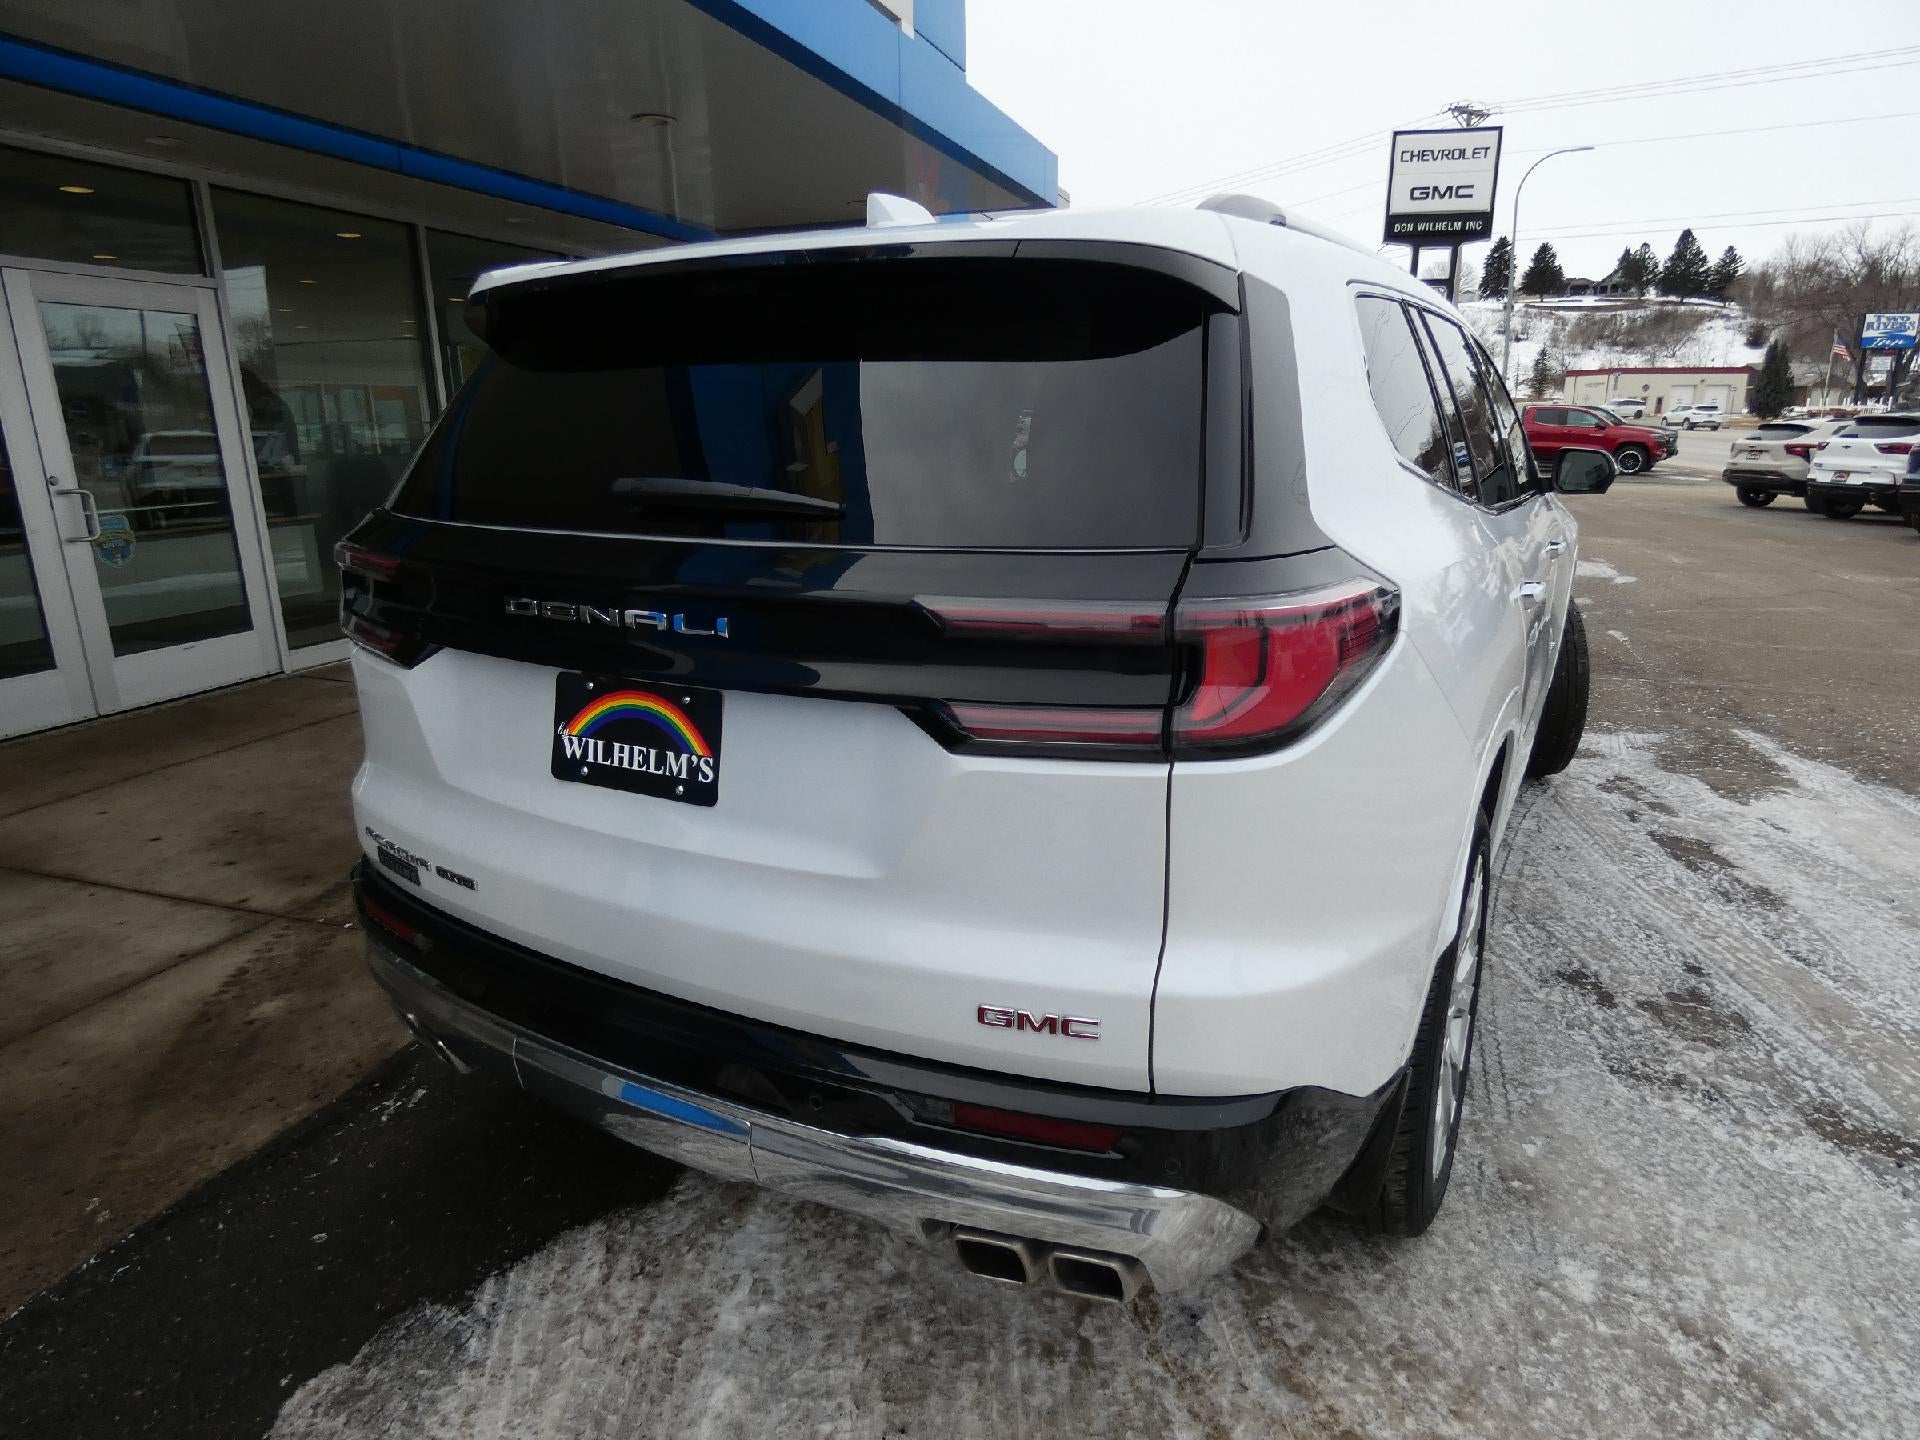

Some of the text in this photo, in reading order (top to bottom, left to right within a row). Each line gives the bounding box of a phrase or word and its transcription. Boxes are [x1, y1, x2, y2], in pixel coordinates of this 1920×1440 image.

[1400, 146, 1491, 163] CHEVROLET
[1409, 184, 1475, 201] GMC
[1393, 220, 1483, 233] DON WILHELM INC
[504, 596, 729, 639] DENALI
[562, 734, 715, 784] WILHELM'S
[977, 1004, 1101, 1040] GMC
